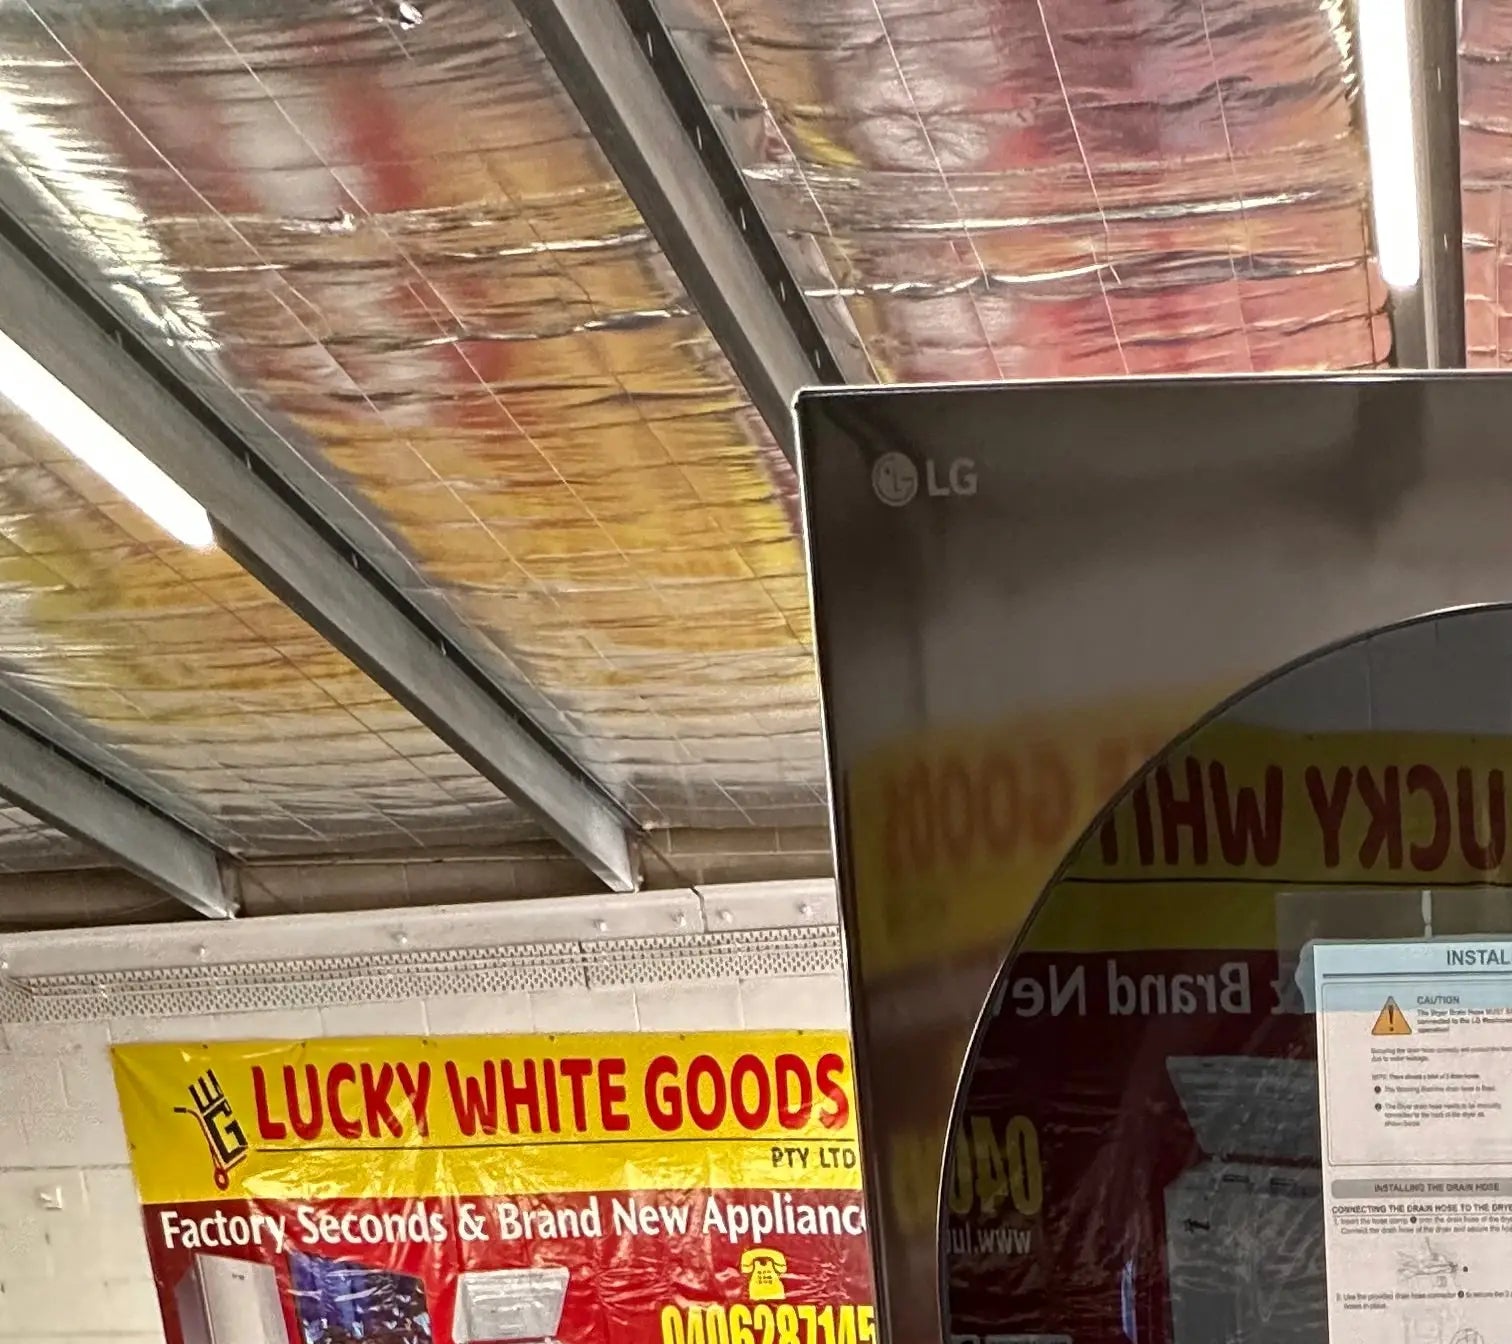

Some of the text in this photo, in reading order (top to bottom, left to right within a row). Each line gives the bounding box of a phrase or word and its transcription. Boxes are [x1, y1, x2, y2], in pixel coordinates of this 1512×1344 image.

[925, 456, 978, 497] LG
[1417, 995, 1460, 1005] CAUTION
[251, 1053, 850, 1141] LUCKY WHITE GOODS
[770, 1146, 856, 1169] PTY LTD
[1426, 1183, 1444, 1192] THE
[1331, 1205, 1387, 1214] CONNECTING
[1388, 1204, 1405, 1213] THE
[1460, 1203, 1472, 1212] TO
[1473, 1203, 1490, 1211] THE
[161, 1191, 867, 1255] Factory Seconds & Brand New Applianc
